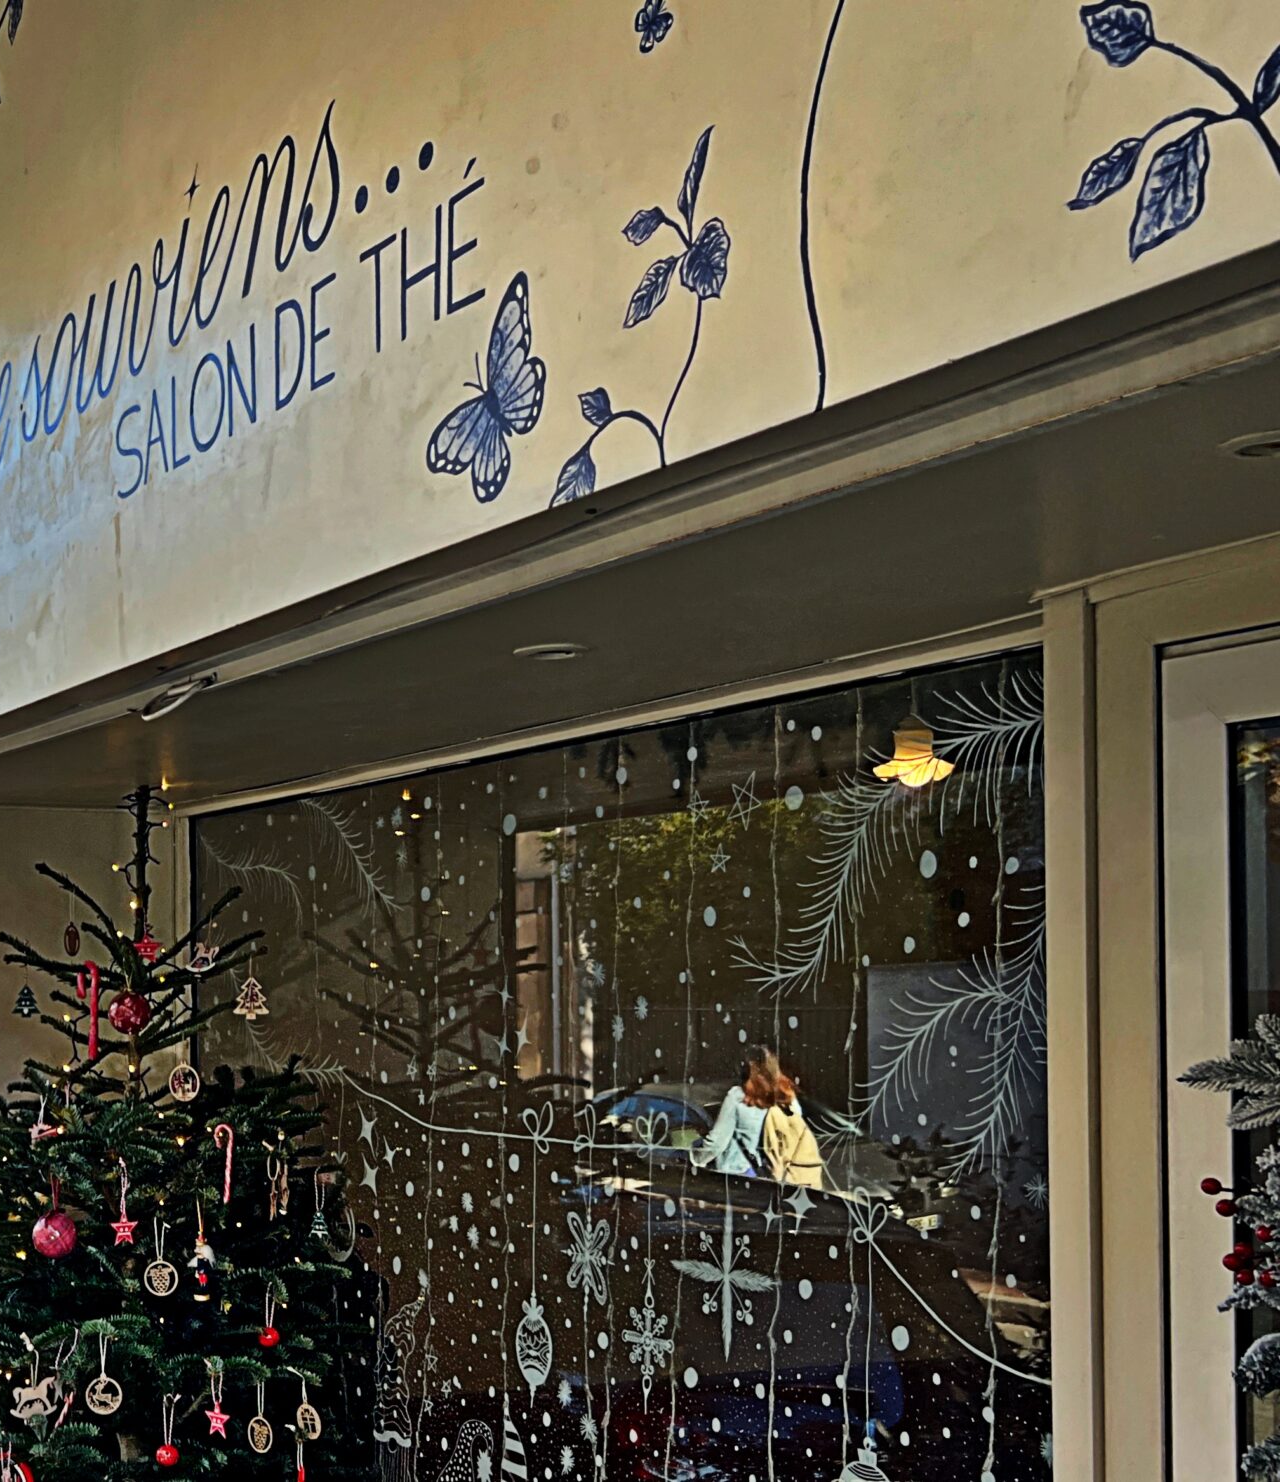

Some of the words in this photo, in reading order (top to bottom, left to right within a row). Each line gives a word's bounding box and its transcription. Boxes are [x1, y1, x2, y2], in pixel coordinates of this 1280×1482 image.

[116, 322, 257, 499] SALON
[275, 272, 337, 411] DE
[359, 157, 486, 354] THÉ
